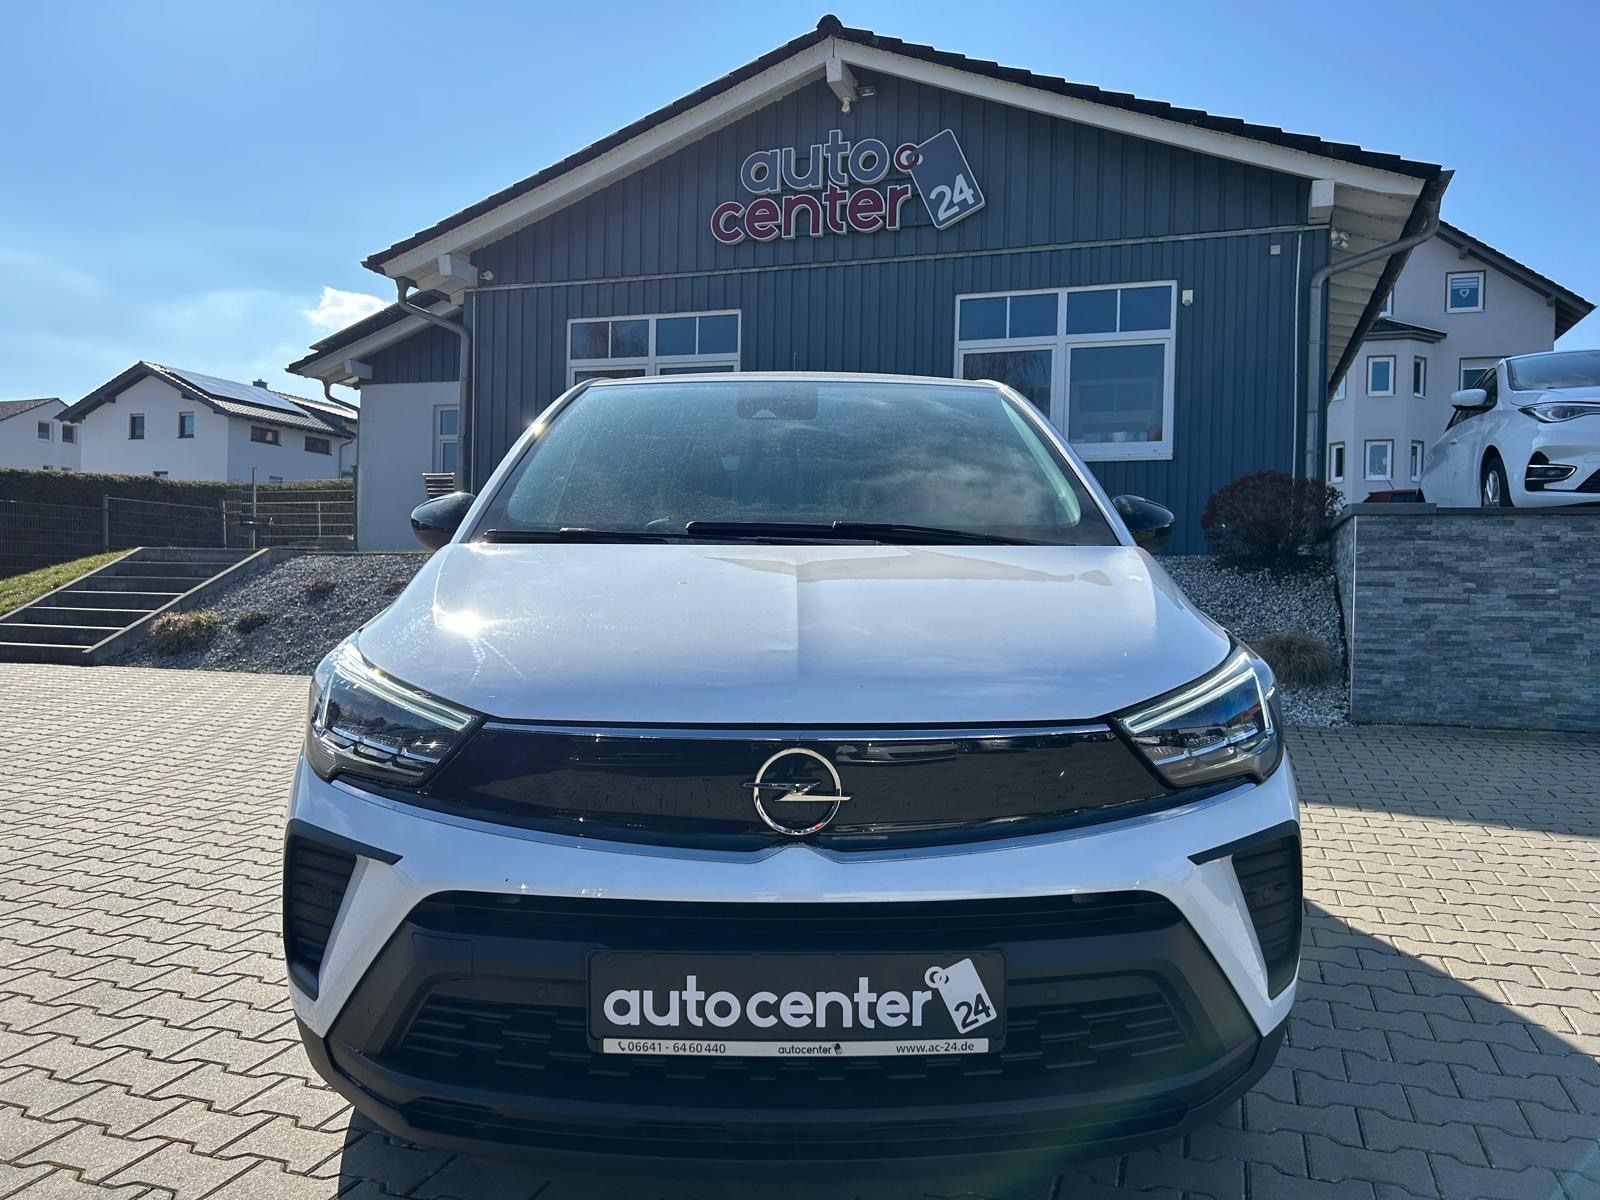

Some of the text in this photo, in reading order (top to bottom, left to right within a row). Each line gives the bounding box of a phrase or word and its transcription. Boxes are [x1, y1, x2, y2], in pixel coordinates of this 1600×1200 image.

[741, 129, 890, 193] auto
[711, 183, 912, 244] center
[929, 173, 975, 222] 24
[954, 993, 991, 1029] 24
[778, 1044, 832, 1055] autocenter
[896, 1042, 975, 1054] www.ac-24.de
